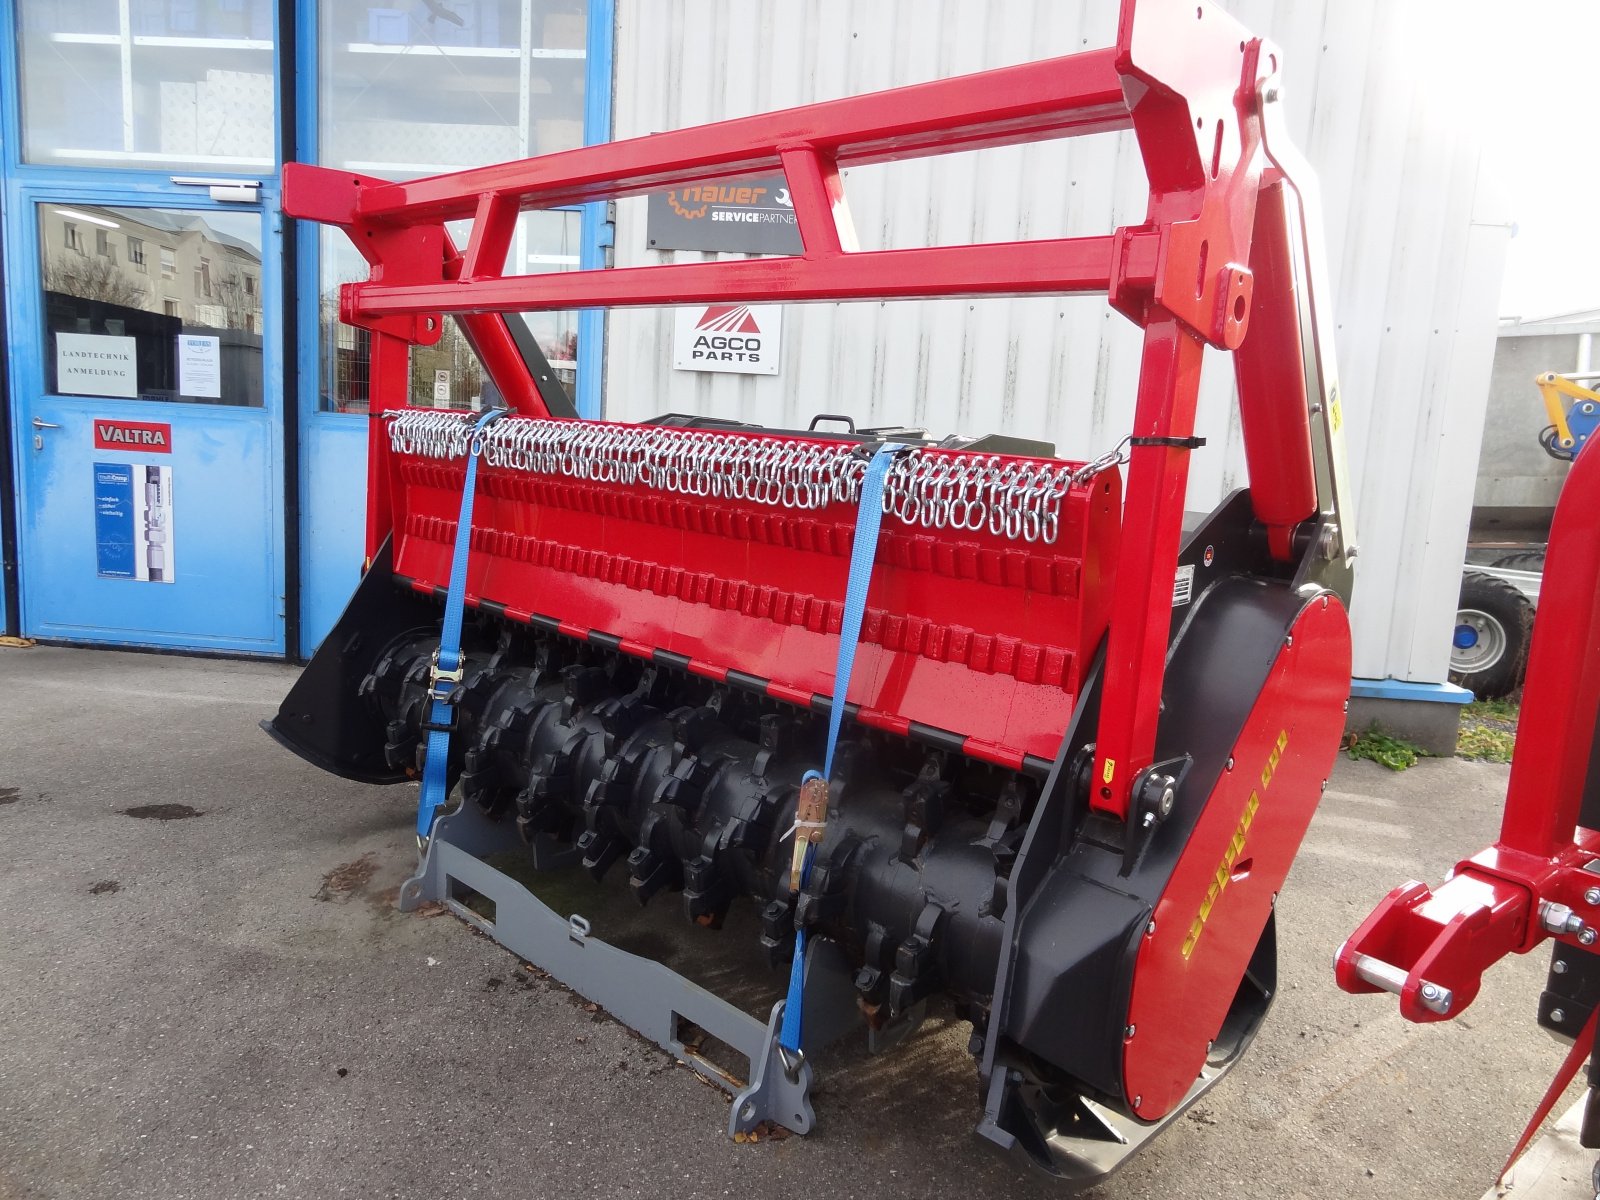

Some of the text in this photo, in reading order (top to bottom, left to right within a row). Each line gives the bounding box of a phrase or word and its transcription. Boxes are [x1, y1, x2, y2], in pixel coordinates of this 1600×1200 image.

[693, 335, 761, 352] AGCO
[62, 350, 129, 361] LANDTECHNIK
[692, 350, 760, 363] PARTS
[67, 367, 126, 377] ANMELDUNG
[98, 425, 165, 445] VALTRA
